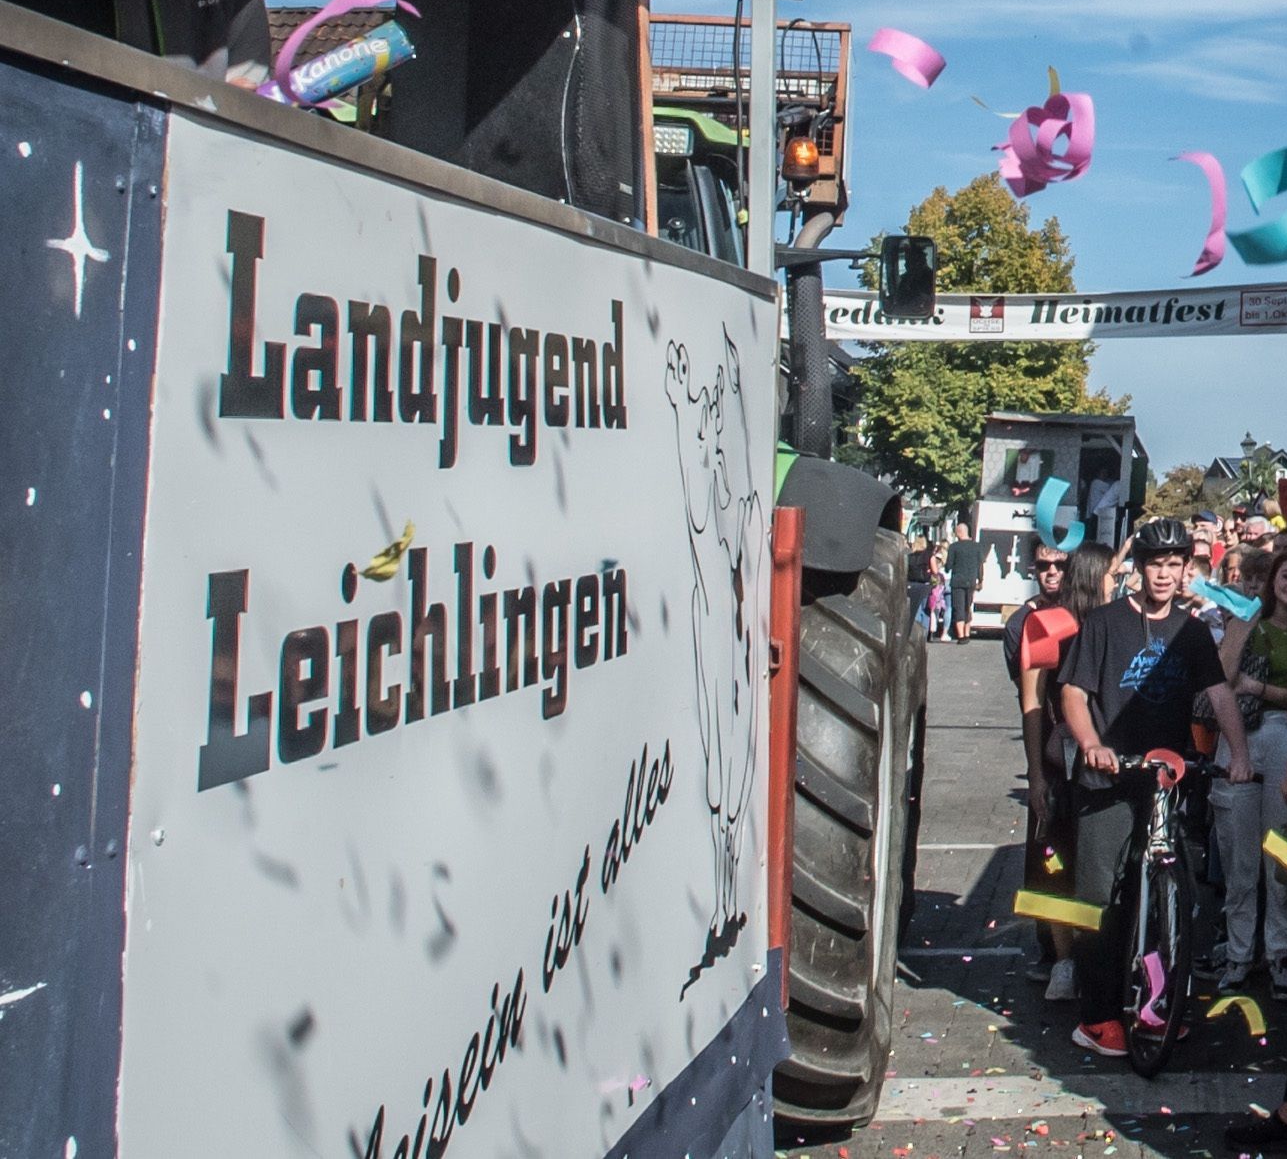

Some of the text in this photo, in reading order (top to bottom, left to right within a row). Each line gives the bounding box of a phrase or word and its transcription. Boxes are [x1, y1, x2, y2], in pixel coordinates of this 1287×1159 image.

[289, 38, 390, 94] Kanone
[218, 209, 627, 469] Landjugend
[1030, 297, 1226, 324] Heimatfest
[199, 542, 627, 792] Leichlingen
[543, 844, 590, 993] ist
[602, 738, 675, 894] alles
